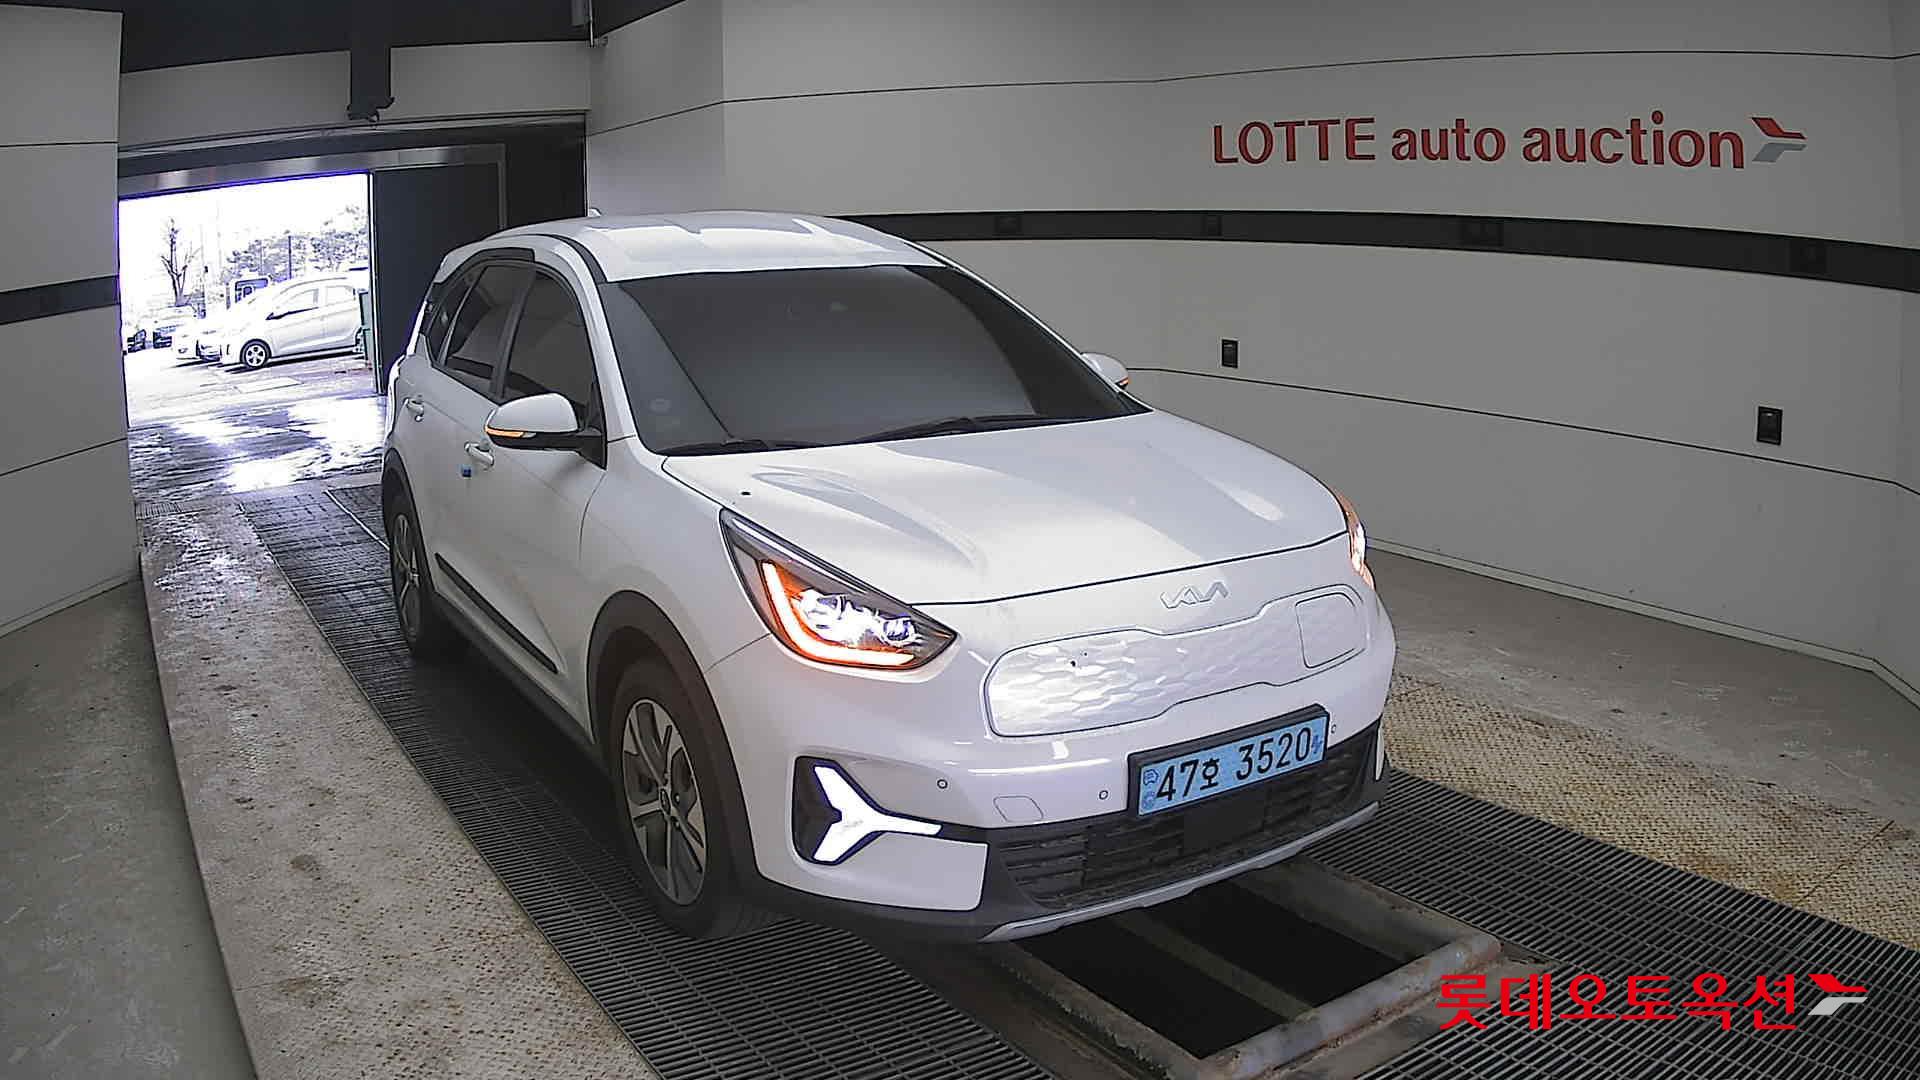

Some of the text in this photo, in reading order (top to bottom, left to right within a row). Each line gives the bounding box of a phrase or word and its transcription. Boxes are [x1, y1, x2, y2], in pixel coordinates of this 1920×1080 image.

[1212, 110, 1745, 169] LOTTE auto auction
[1156, 727, 1312, 802] 47호 3520
